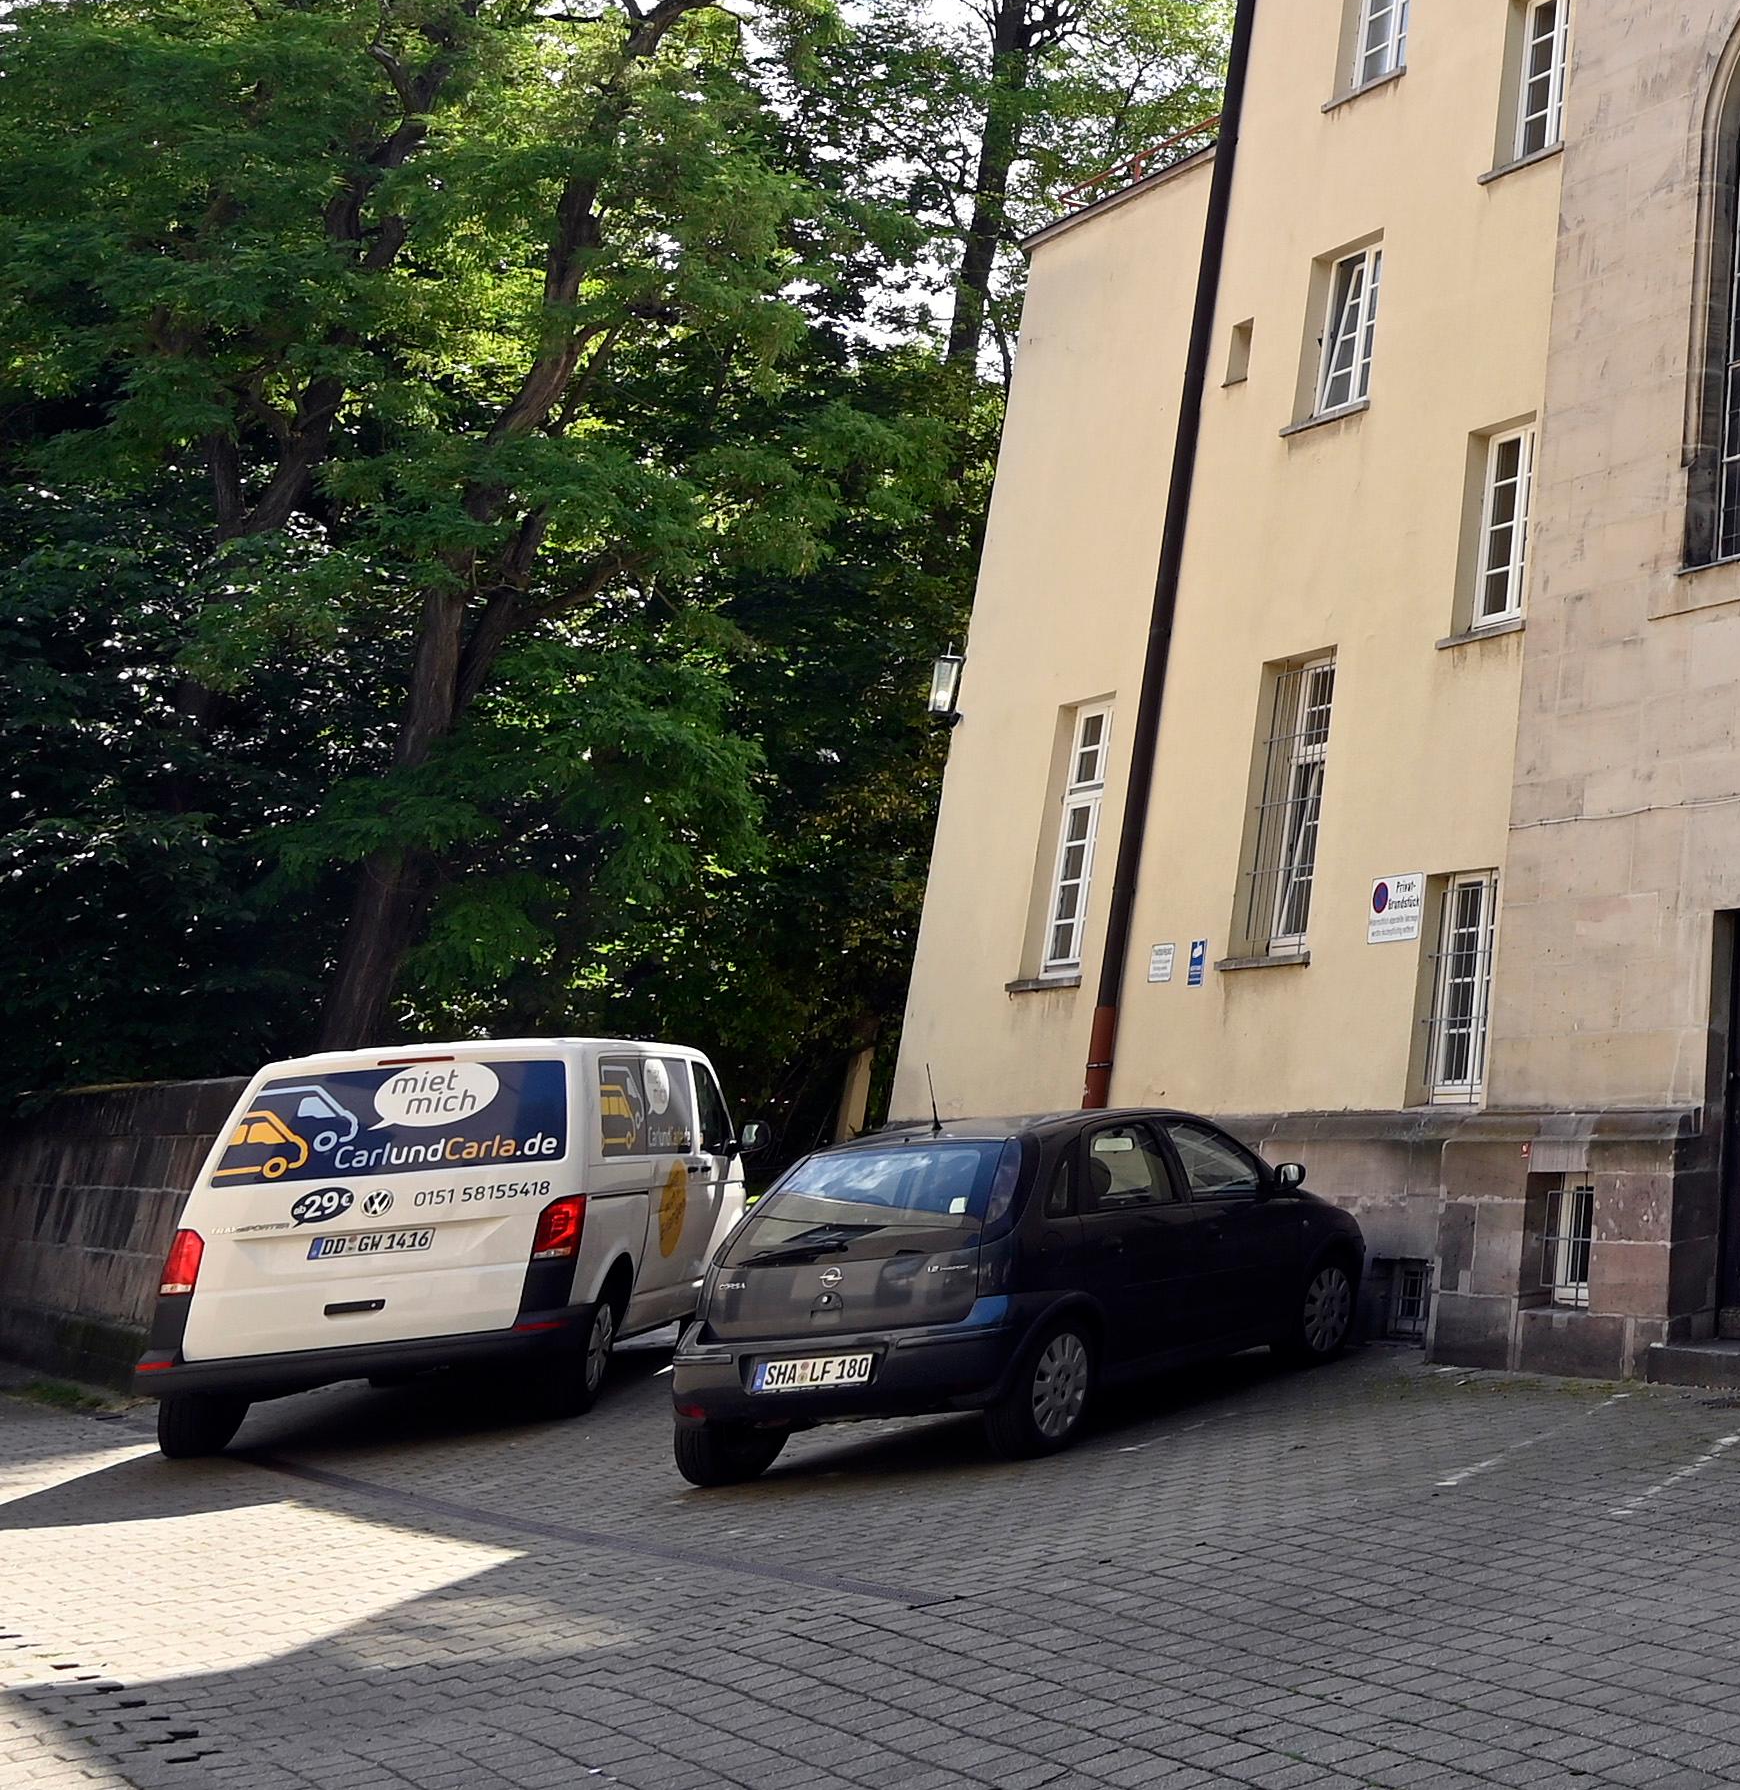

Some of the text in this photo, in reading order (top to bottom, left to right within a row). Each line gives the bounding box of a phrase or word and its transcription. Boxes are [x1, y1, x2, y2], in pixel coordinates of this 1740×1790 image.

[391, 1068, 459, 1095] miet
[405, 1089, 477, 1115] mich
[334, 1132, 558, 1169] CarlundCarla.de
[414, 1180, 550, 1207] 0151 58155418
[321, 1238, 346, 1255] DD
[384, 1230, 429, 1250] 1416
[765, 1357, 870, 1385] SHA LF 180
